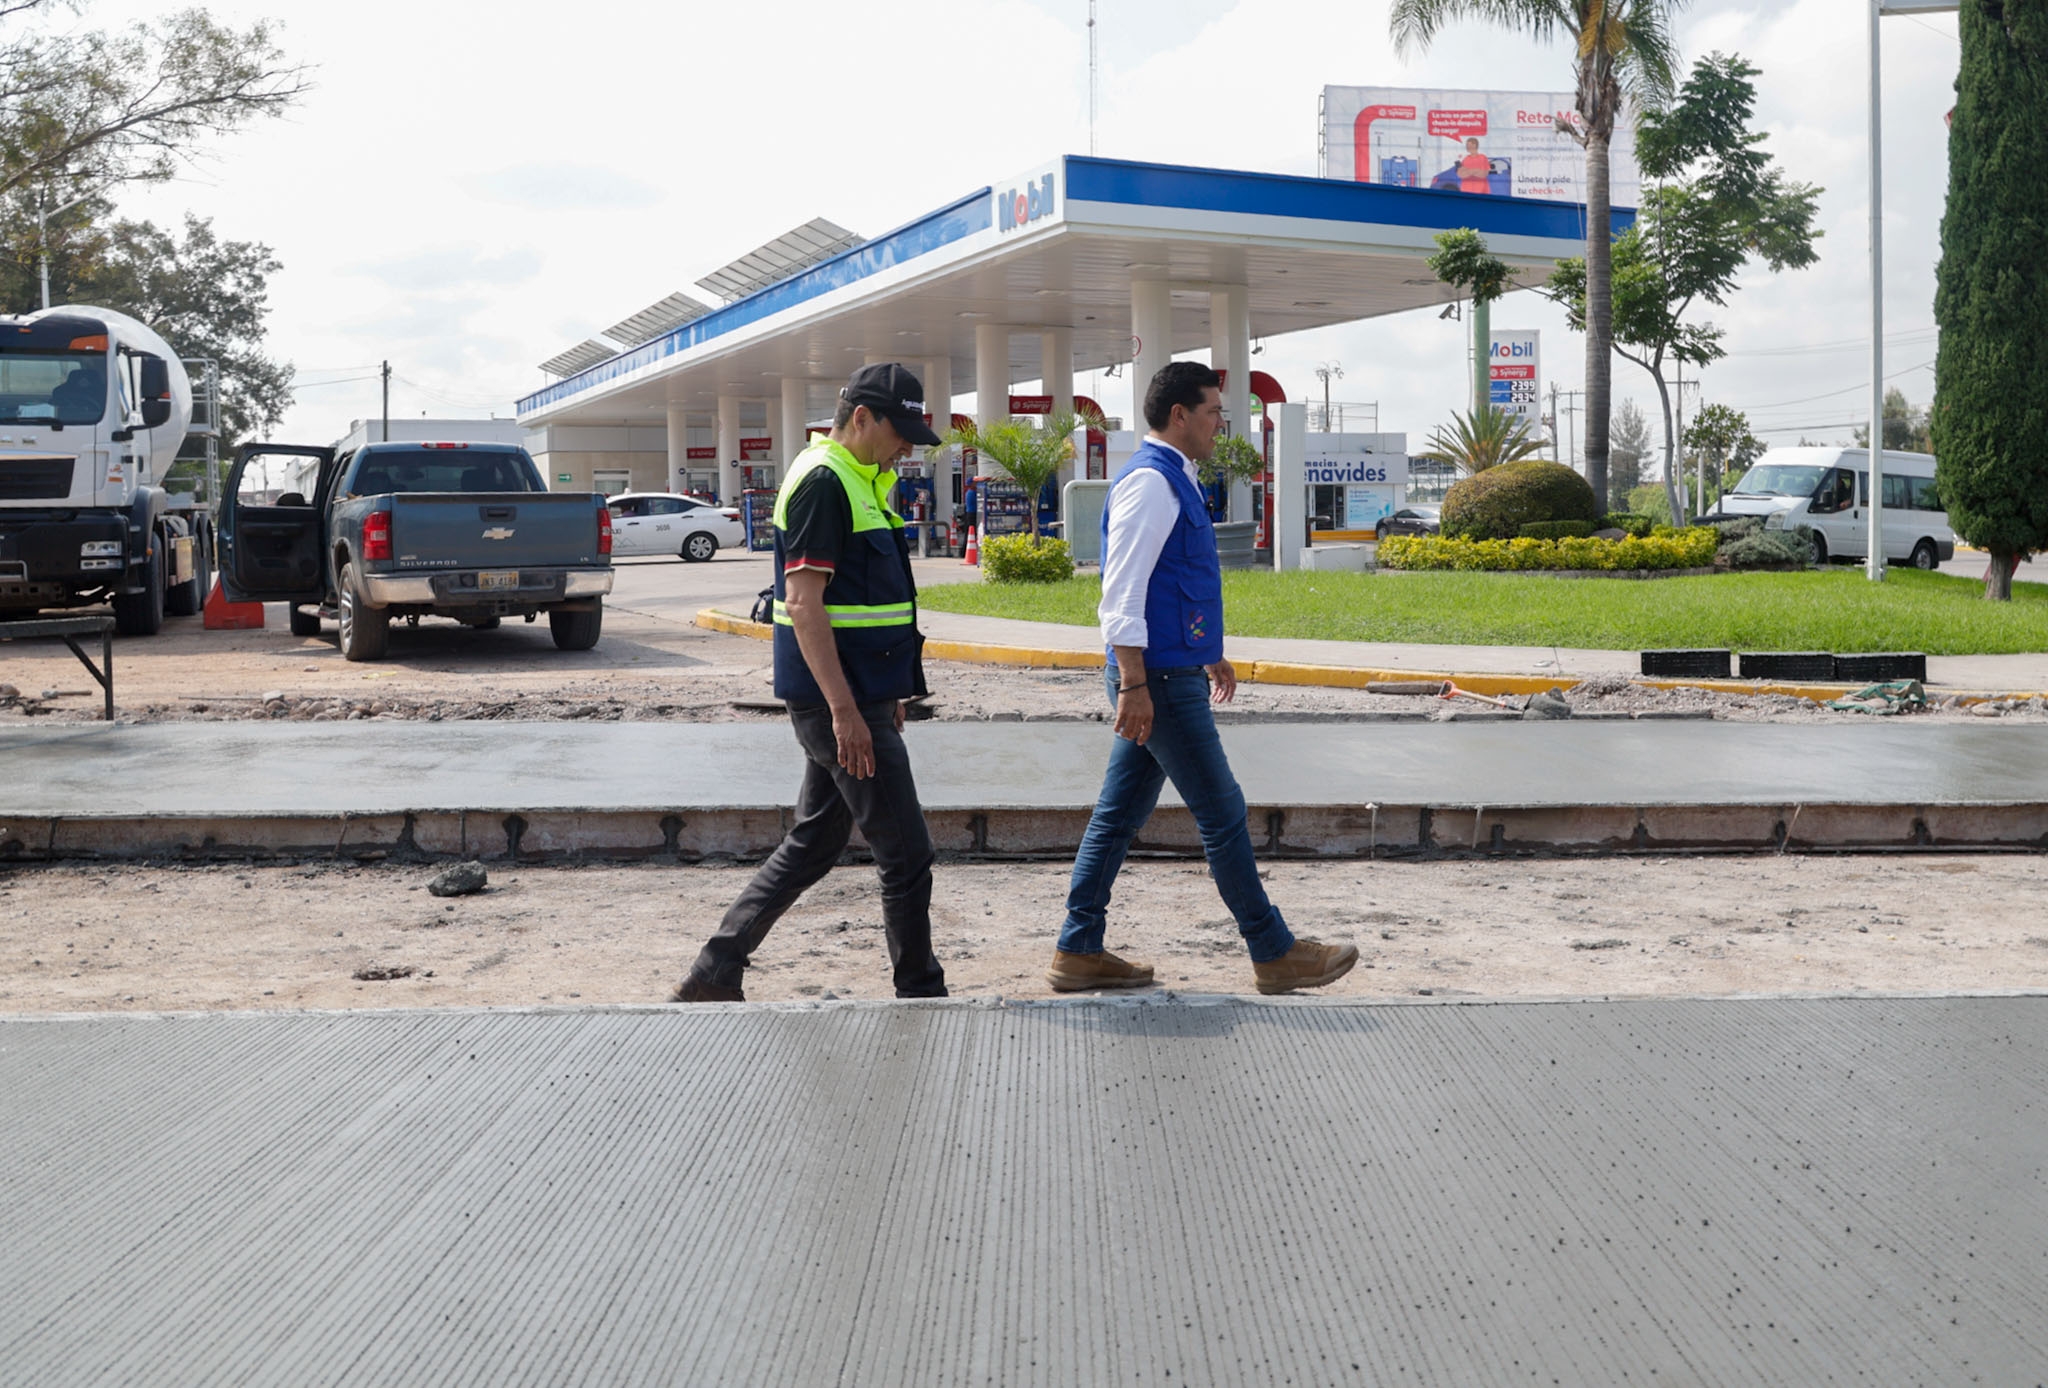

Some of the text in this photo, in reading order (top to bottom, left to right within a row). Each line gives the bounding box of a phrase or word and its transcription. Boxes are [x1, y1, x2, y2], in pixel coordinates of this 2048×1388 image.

[1516, 110, 1552, 124] Reto
[1545, 176, 1551, 184] y
[1552, 175, 1571, 184] pide
[1518, 187, 1527, 195] tu
[998, 172, 1054, 233] Mobil
[1489, 341, 1533, 357] Mobil
[1500, 369, 1527, 378] Synergy
[1511, 381, 1535, 391] 2399
[1511, 392, 1535, 402] 2934
[1022, 401, 1050, 410] Synergy
[1304, 459, 1338, 468] macias
[1304, 461, 1387, 482] navides
[400, 559, 458, 567] SILVERADO
